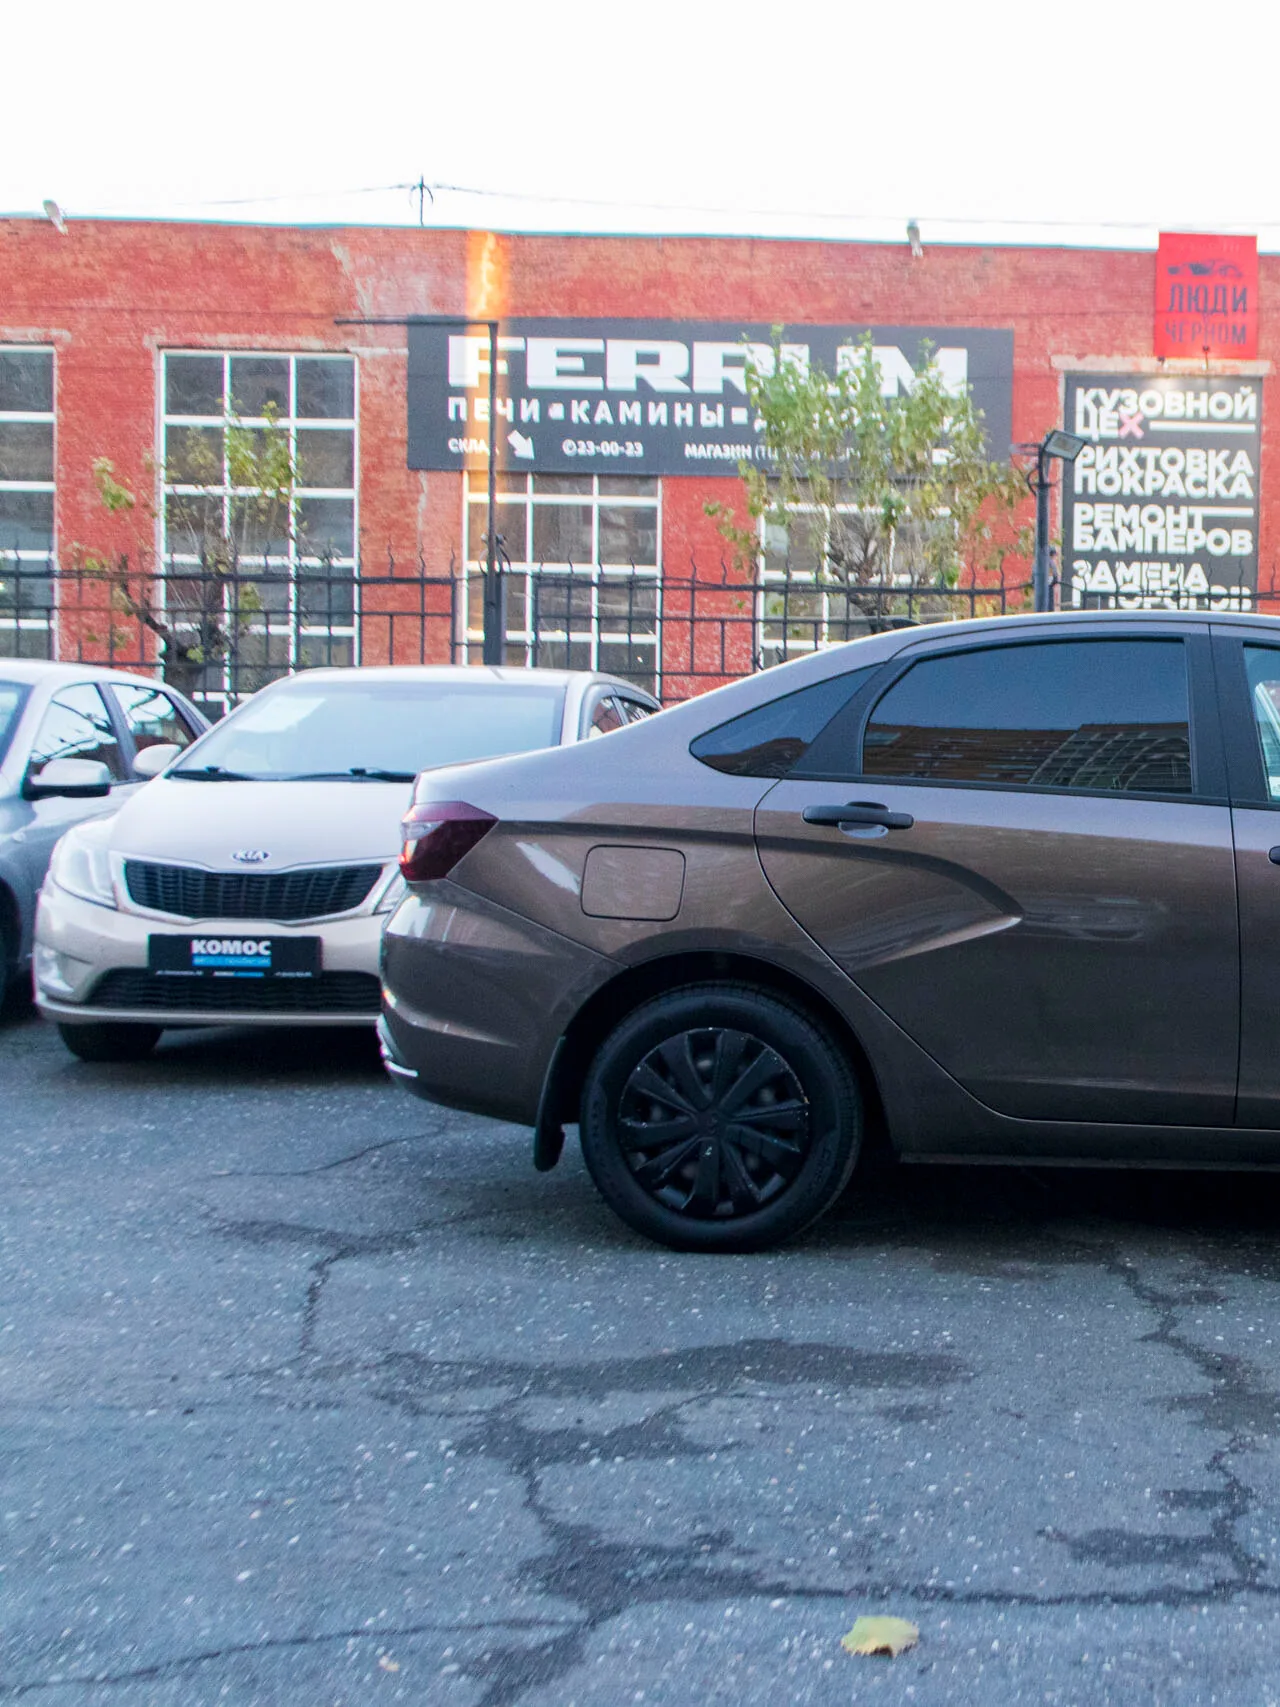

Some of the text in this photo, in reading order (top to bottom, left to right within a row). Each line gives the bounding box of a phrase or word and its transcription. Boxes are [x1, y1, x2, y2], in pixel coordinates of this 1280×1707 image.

[1167, 284, 1247, 316] ЛЮДИ
[448, 397, 540, 424] ПЕЧИ
[571, 399, 724, 428] КАМИНЫ
[1075, 386, 1257, 420] КУЗОВНОЙ
[1075, 411, 1145, 442] ЦЕХ
[448, 438, 499, 456] СКЛА
[684, 443, 751, 461] МАГАЗИН
[1075, 445, 1254, 476] РИХТОВКА
[1074, 467, 1254, 499] ПОКРАСКА
[1073, 502, 1204, 532] РЕМОНТ
[1073, 524, 1253, 556] БАМПЕРОВ
[1072, 559, 1209, 593] ЗАМЕНА
[192, 939, 271, 956] КОМОС
